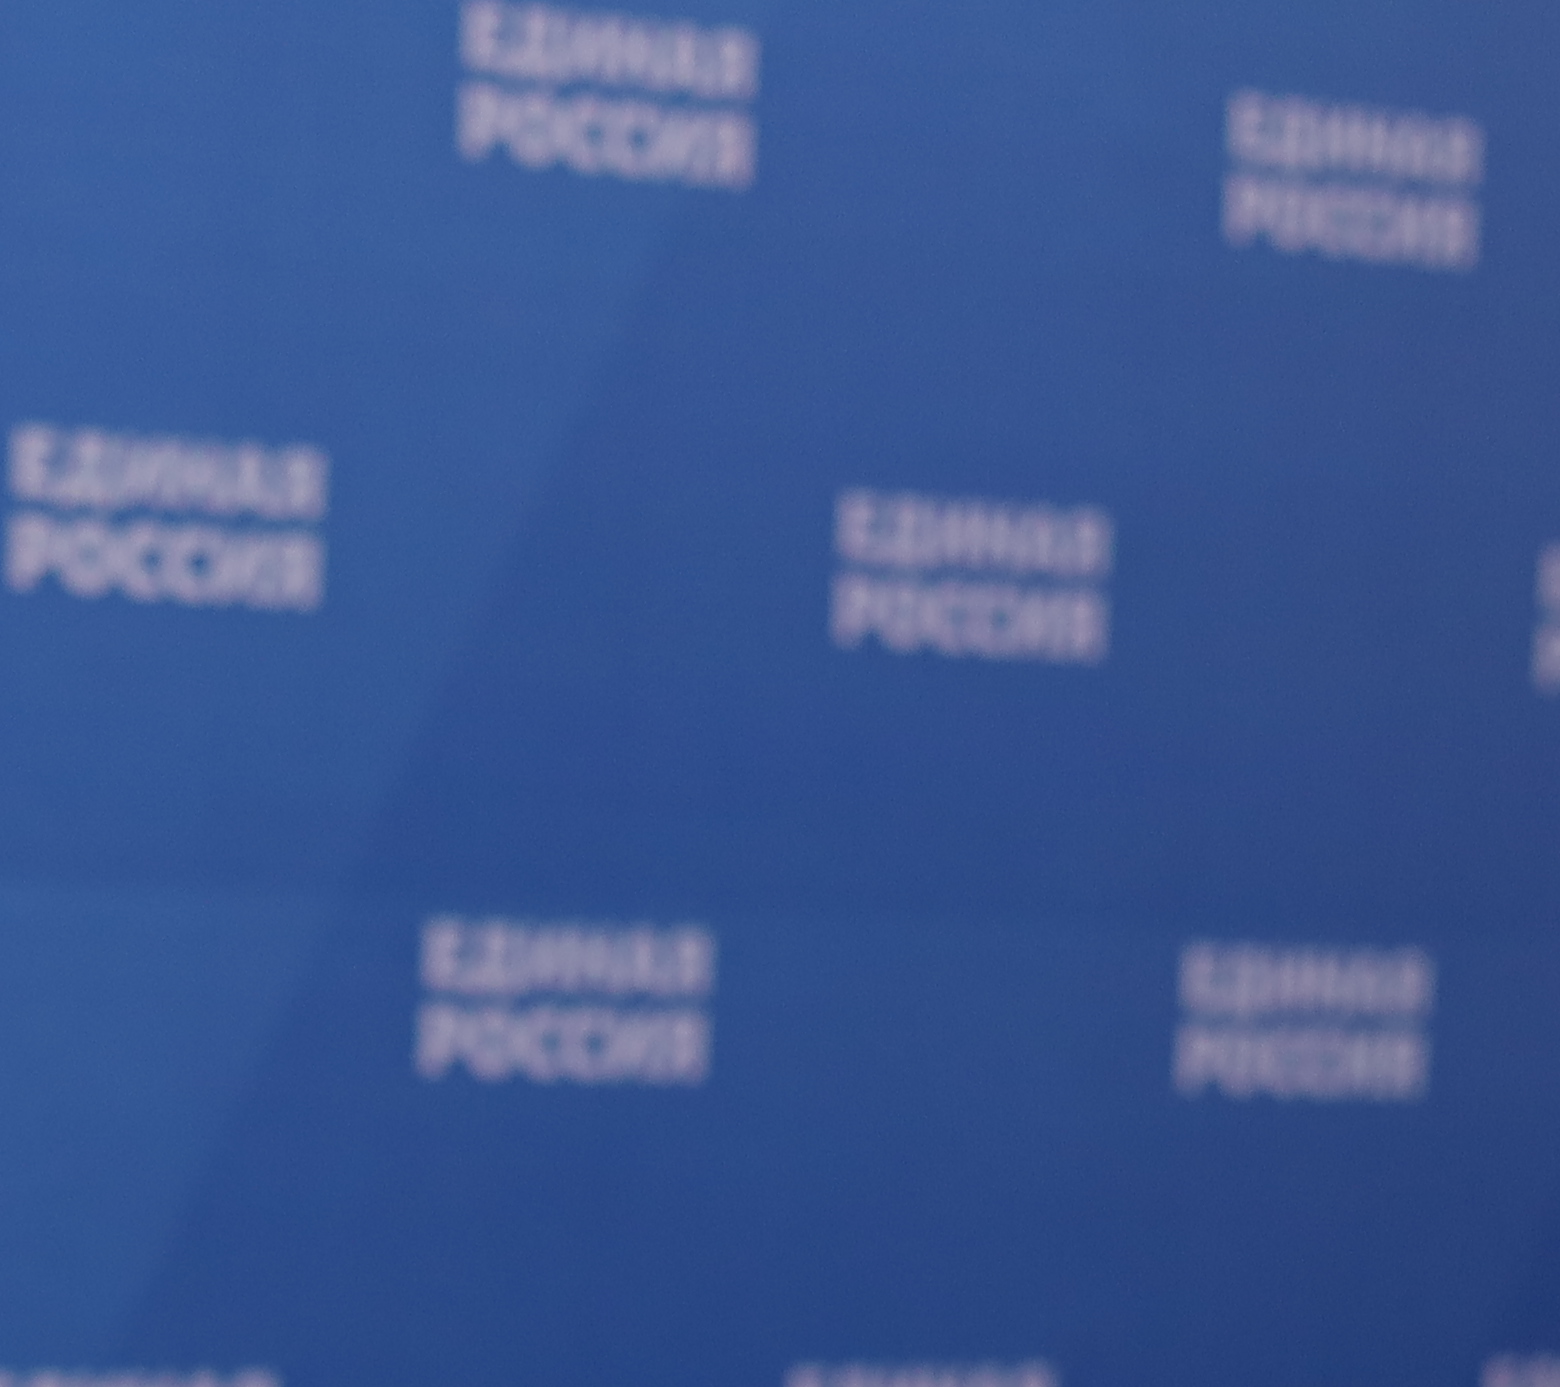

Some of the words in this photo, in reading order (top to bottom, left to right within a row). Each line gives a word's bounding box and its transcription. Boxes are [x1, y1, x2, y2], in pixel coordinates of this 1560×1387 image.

[462, 0, 756, 98] ЕДИНАЯ
[459, 82, 753, 184] РОССИЯ
[11, 425, 325, 518] ЕДИНАЯ
[7, 512, 322, 606] РОССИЯ
[422, 920, 712, 999] ЕДИНАЯ
[417, 998, 708, 1080] РОССИЯ
